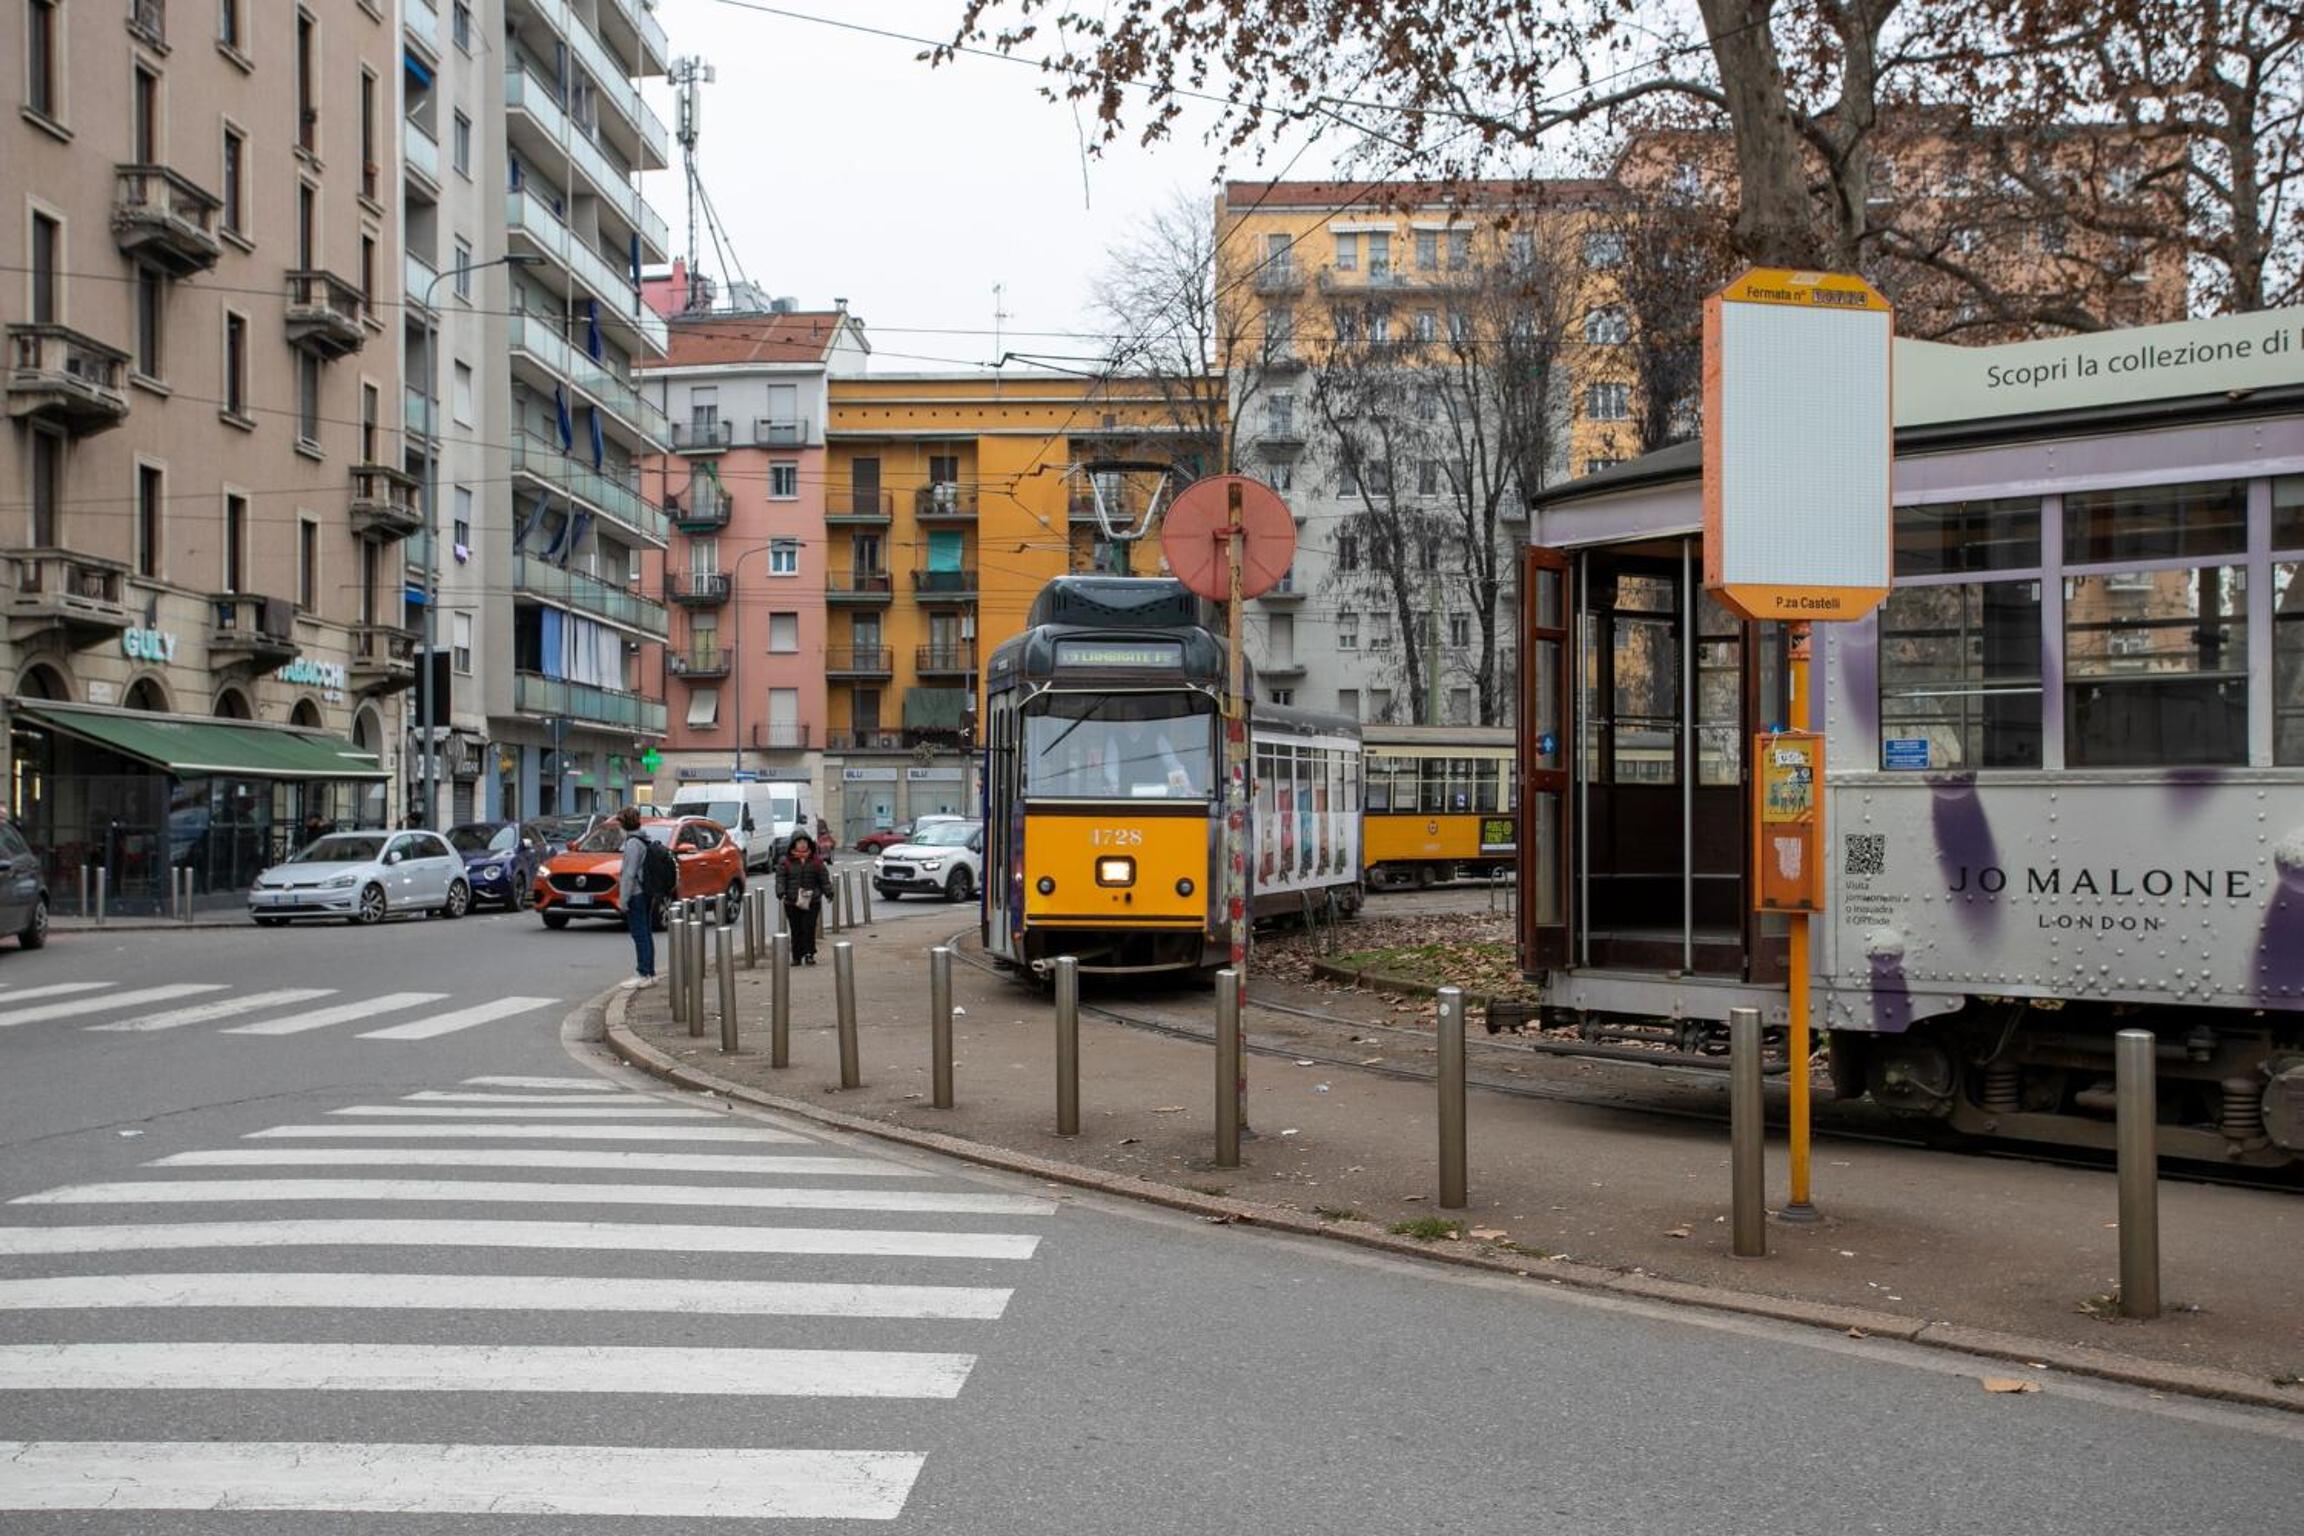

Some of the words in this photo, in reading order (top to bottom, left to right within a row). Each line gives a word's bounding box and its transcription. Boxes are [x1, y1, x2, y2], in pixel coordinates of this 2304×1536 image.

[1747, 286, 1791, 300] Fermata
[1988, 357, 2067, 388] Scopri
[2077, 354, 2098, 377] la
[2108, 340, 2252, 373] collezione
[2262, 329, 2289, 354] di
[1776, 596, 1798, 608] P.za
[1800, 596, 1841, 609] Castelli
[122, 627, 177, 663] GULY
[1949, 866, 2007, 893] JO
[2027, 867, 2252, 899] MALONE
[2039, 914, 2159, 930] LONDON
